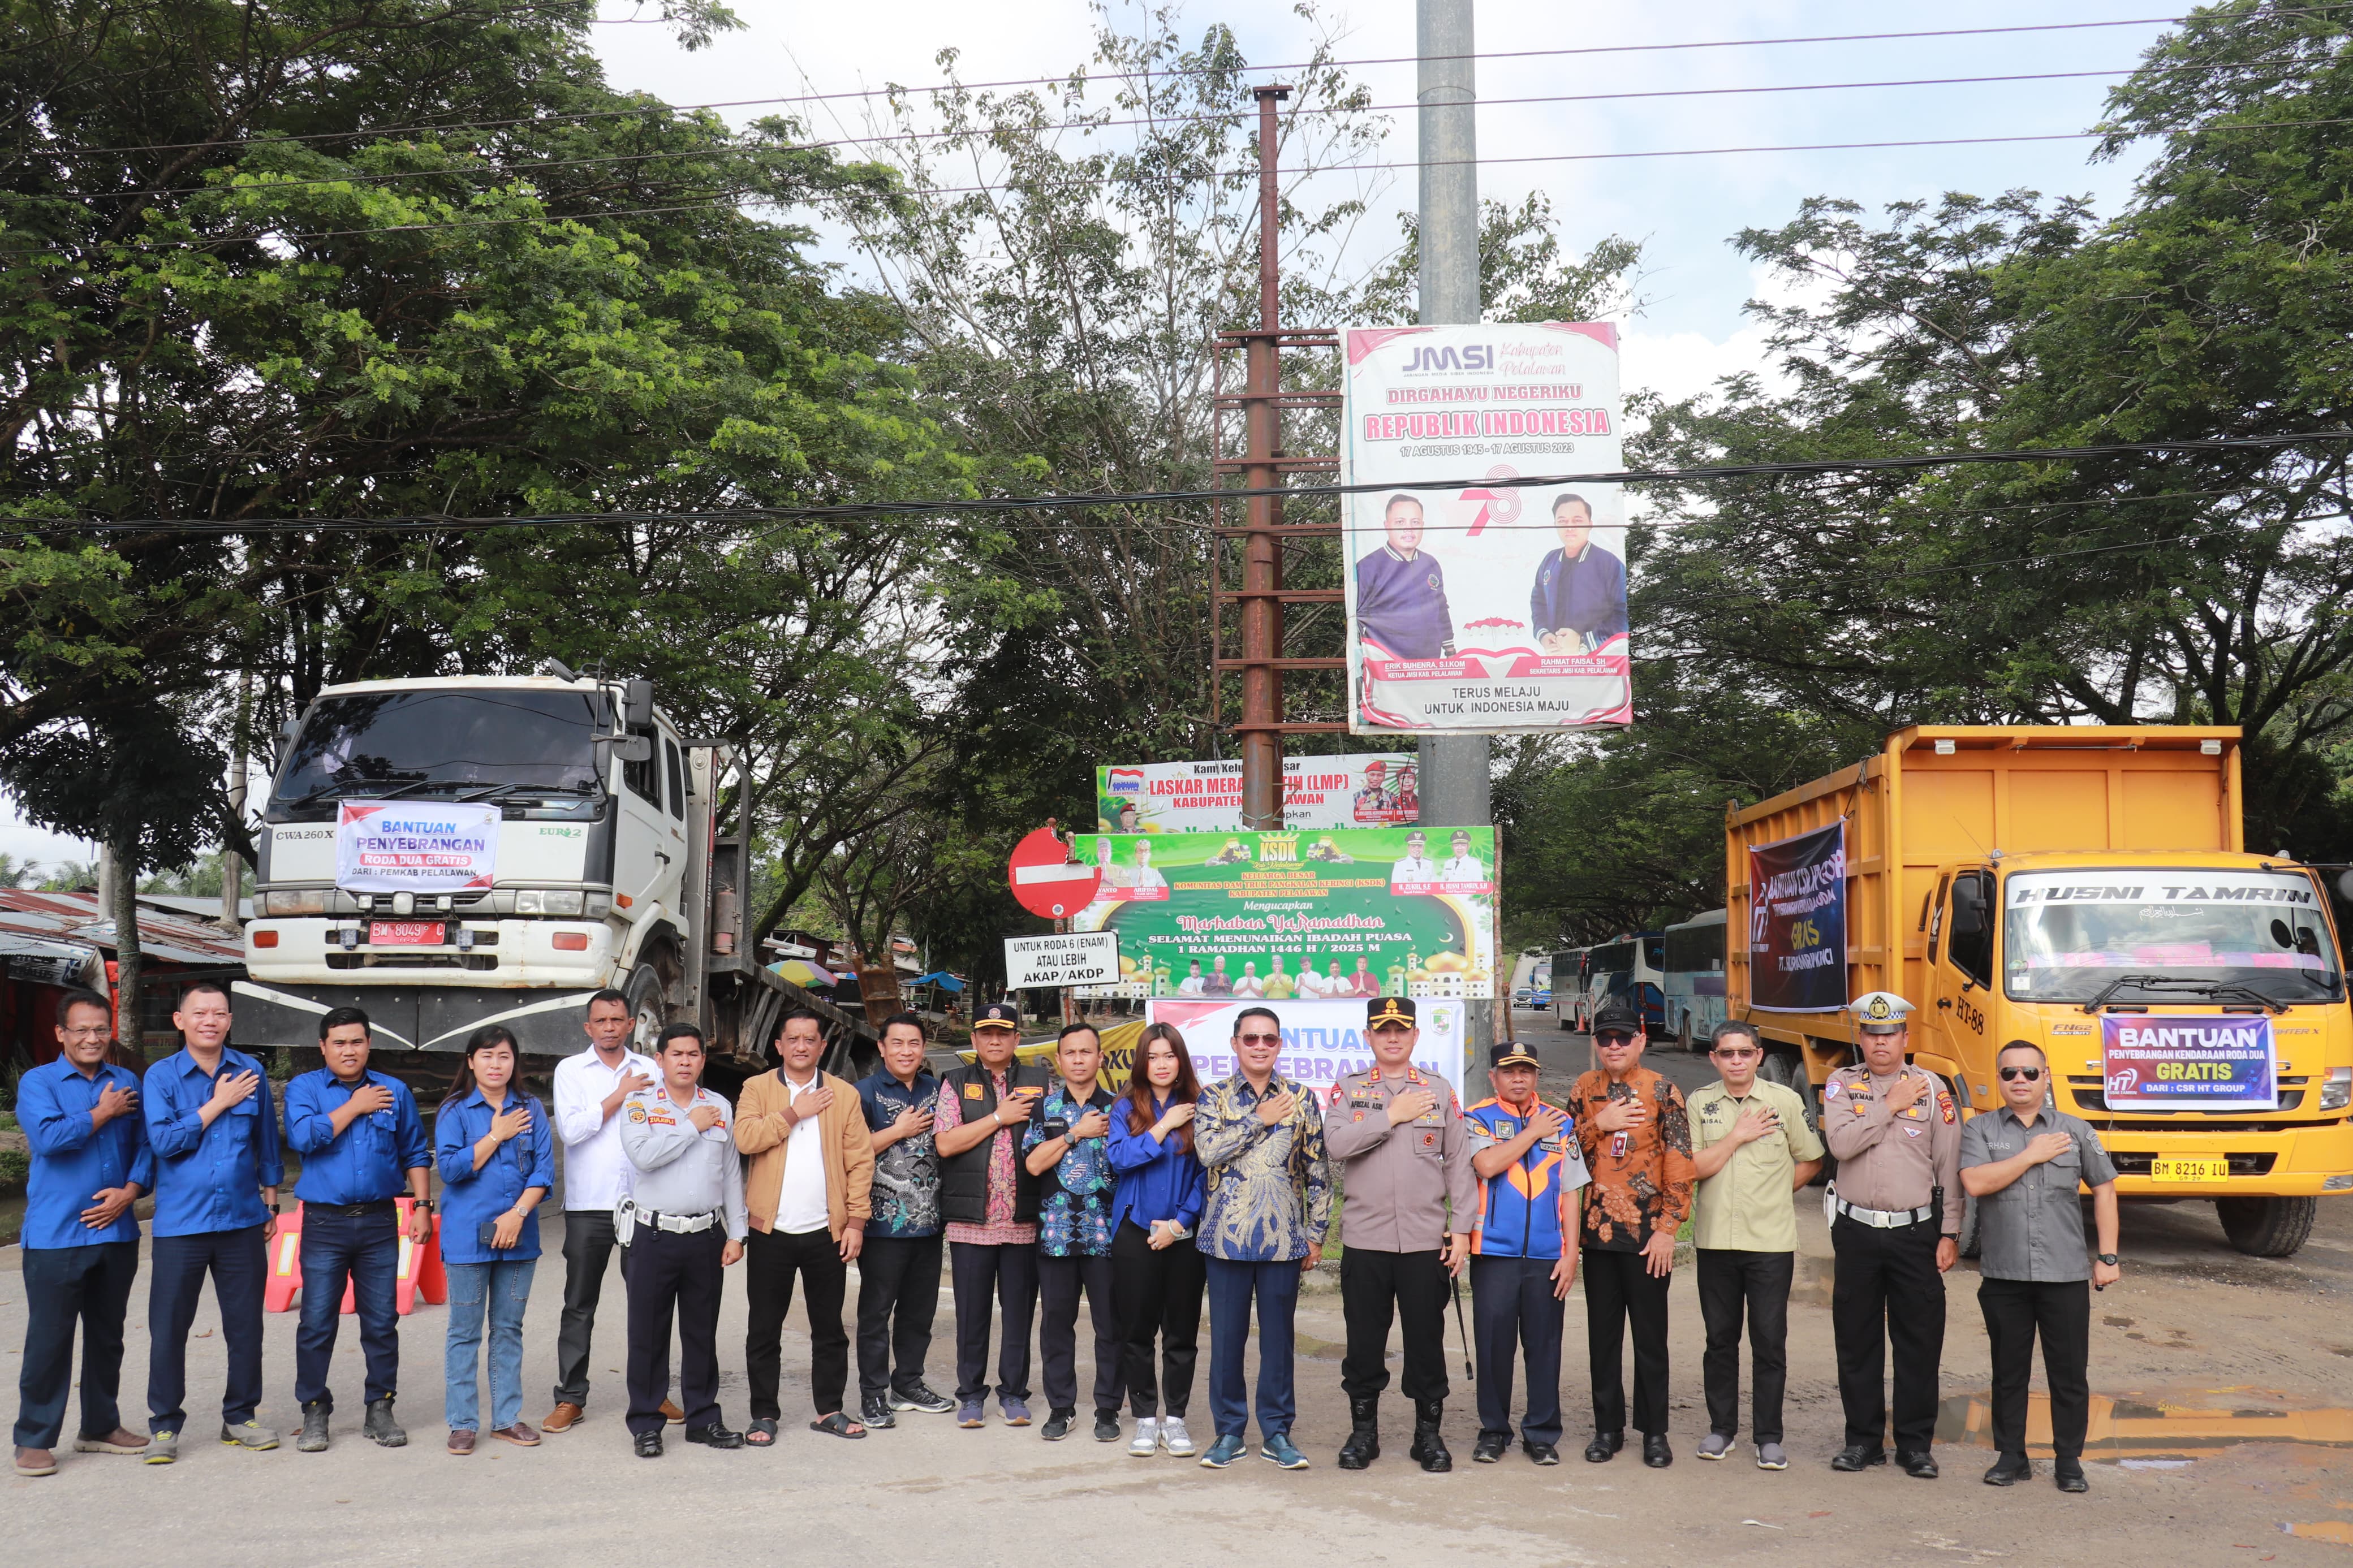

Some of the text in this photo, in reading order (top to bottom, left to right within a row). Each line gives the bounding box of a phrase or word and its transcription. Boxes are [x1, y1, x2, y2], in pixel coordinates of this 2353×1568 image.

[1402, 345, 1494, 372] JMSI
[1387, 384, 1583, 404] DIRGAHAYU NEGERIKU
[1365, 409, 1610, 440] REPUBLIK INDONESIA
[1400, 446, 1411, 456] 17
[1413, 445, 1460, 456] AGUSTUS
[1462, 444, 1483, 455] 1945
[1492, 444, 1502, 454] 17
[1503, 443, 1550, 453] AGUSTUS
[1552, 443, 1574, 453] 2023
[1402, 662, 1438, 670] SUHENRA,
[1452, 686, 1541, 699] TERUS MELAJU
[1424, 700, 1570, 714] UNTUK INDONESIA MAJU
[1222, 764, 1243, 772] Kelu
[1149, 774, 1349, 795] LASKAR MERA TIH (LMP)
[1285, 793, 1324, 805] AWAN
[382, 820, 456, 834] BANTUAN
[357, 837, 485, 851] PENYEBRANGAN
[1260, 841, 1298, 862] KSDK
[364, 855, 468, 865] RODA DUA GRATIS
[1268, 880, 1318, 888] PANGKALAN
[1319, 879, 1354, 888] KERINCI
[1355, 879, 1386, 887] (KSDK)
[1229, 889, 1328, 898] KABUPATEN PELALAWAN
[2015, 886, 2311, 905] HUSNI TAMRIN
[1244, 901, 1313, 913] Mengucapkan
[373, 923, 443, 936] BM 8049 C
[1176, 914, 1266, 934] Marhaban
[1294, 912, 1385, 934] Ramadhan
[1014, 937, 1108, 952] UNTUK RODA 6 (ENAM)
[1148, 932, 1412, 944] SELAMAT MENUNAIKAN IBADAH PUASA
[1178, 945, 1184, 954] 1
[1188, 945, 1266, 954] RAMADHAN
[1270, 944, 1302, 953] 1446
[1306, 944, 1317, 953] H
[1330, 944, 1364, 952] 2025
[1368, 943, 1381, 952] M
[1037, 953, 1087, 967] ATAU LEBIH
[1956, 995, 1984, 1036] HT-88
[2119, 1028, 2257, 1048] BANTUAN
[2109, 1049, 2265, 1060] PENYEBRANGAN KENDARAAN RODA DUA
[2156, 1062, 2232, 1081] GRATIS
[2108, 1076, 2132, 1091] HT
[2176, 1084, 2195, 1092] CSR
[2213, 1084, 2246, 1092] GROUP
[1848, 1093, 1873, 1102] UKMAN
[2154, 1163, 2226, 1176] BM 8216 IU
